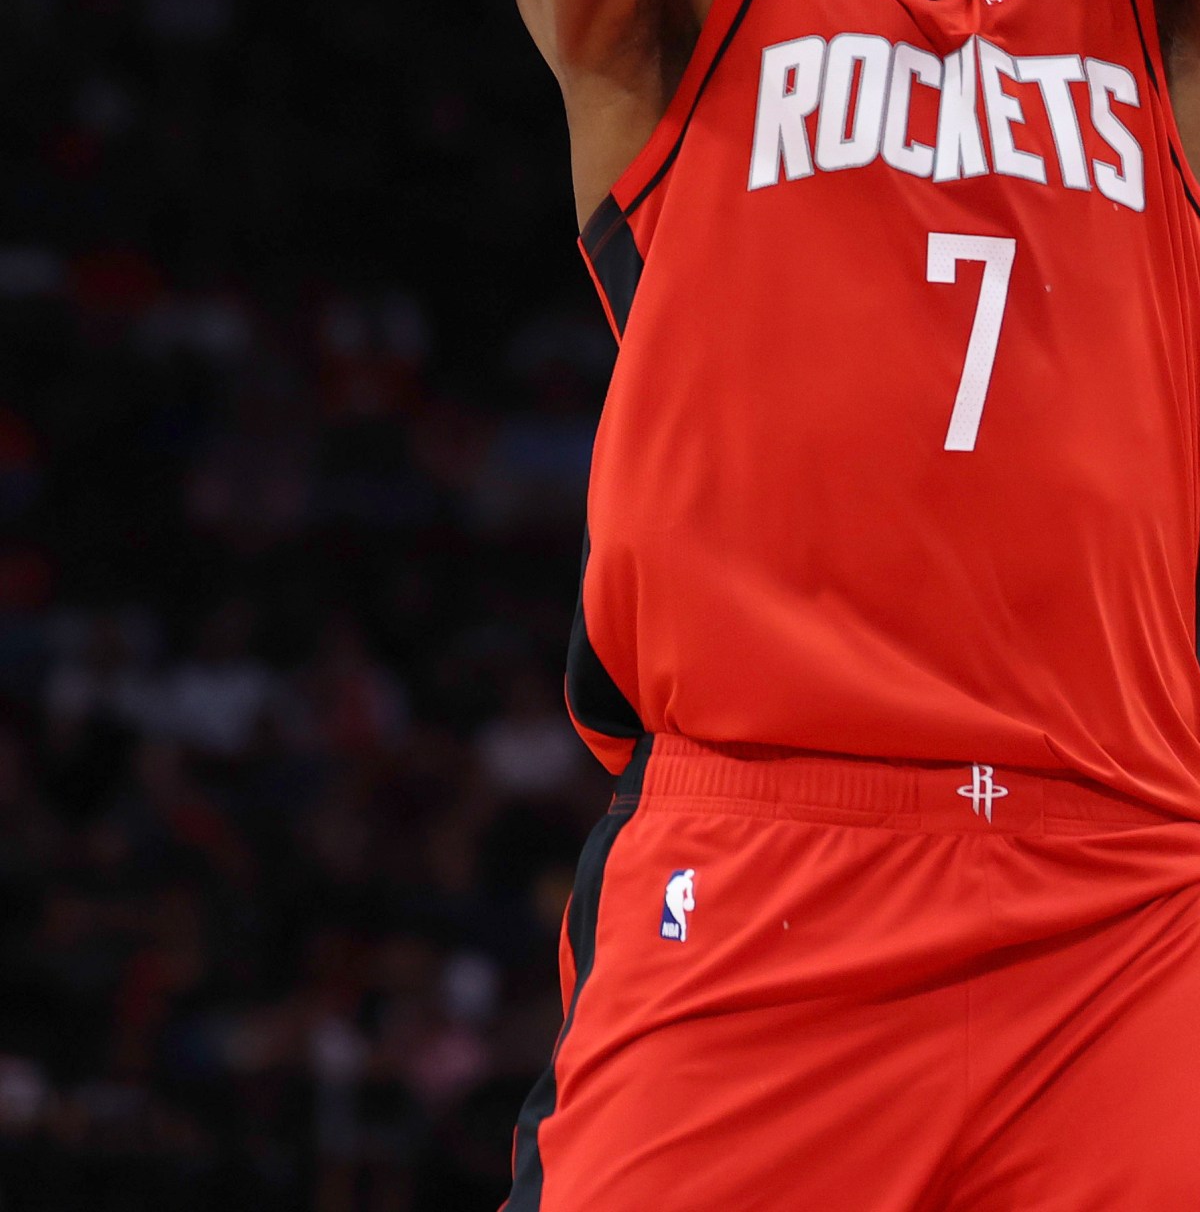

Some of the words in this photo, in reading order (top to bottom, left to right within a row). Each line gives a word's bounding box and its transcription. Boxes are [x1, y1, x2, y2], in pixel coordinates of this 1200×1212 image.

[748, 32, 1145, 212] ROCKETS
[926, 231, 1016, 452] 7
[660, 920, 681, 939] NBA
